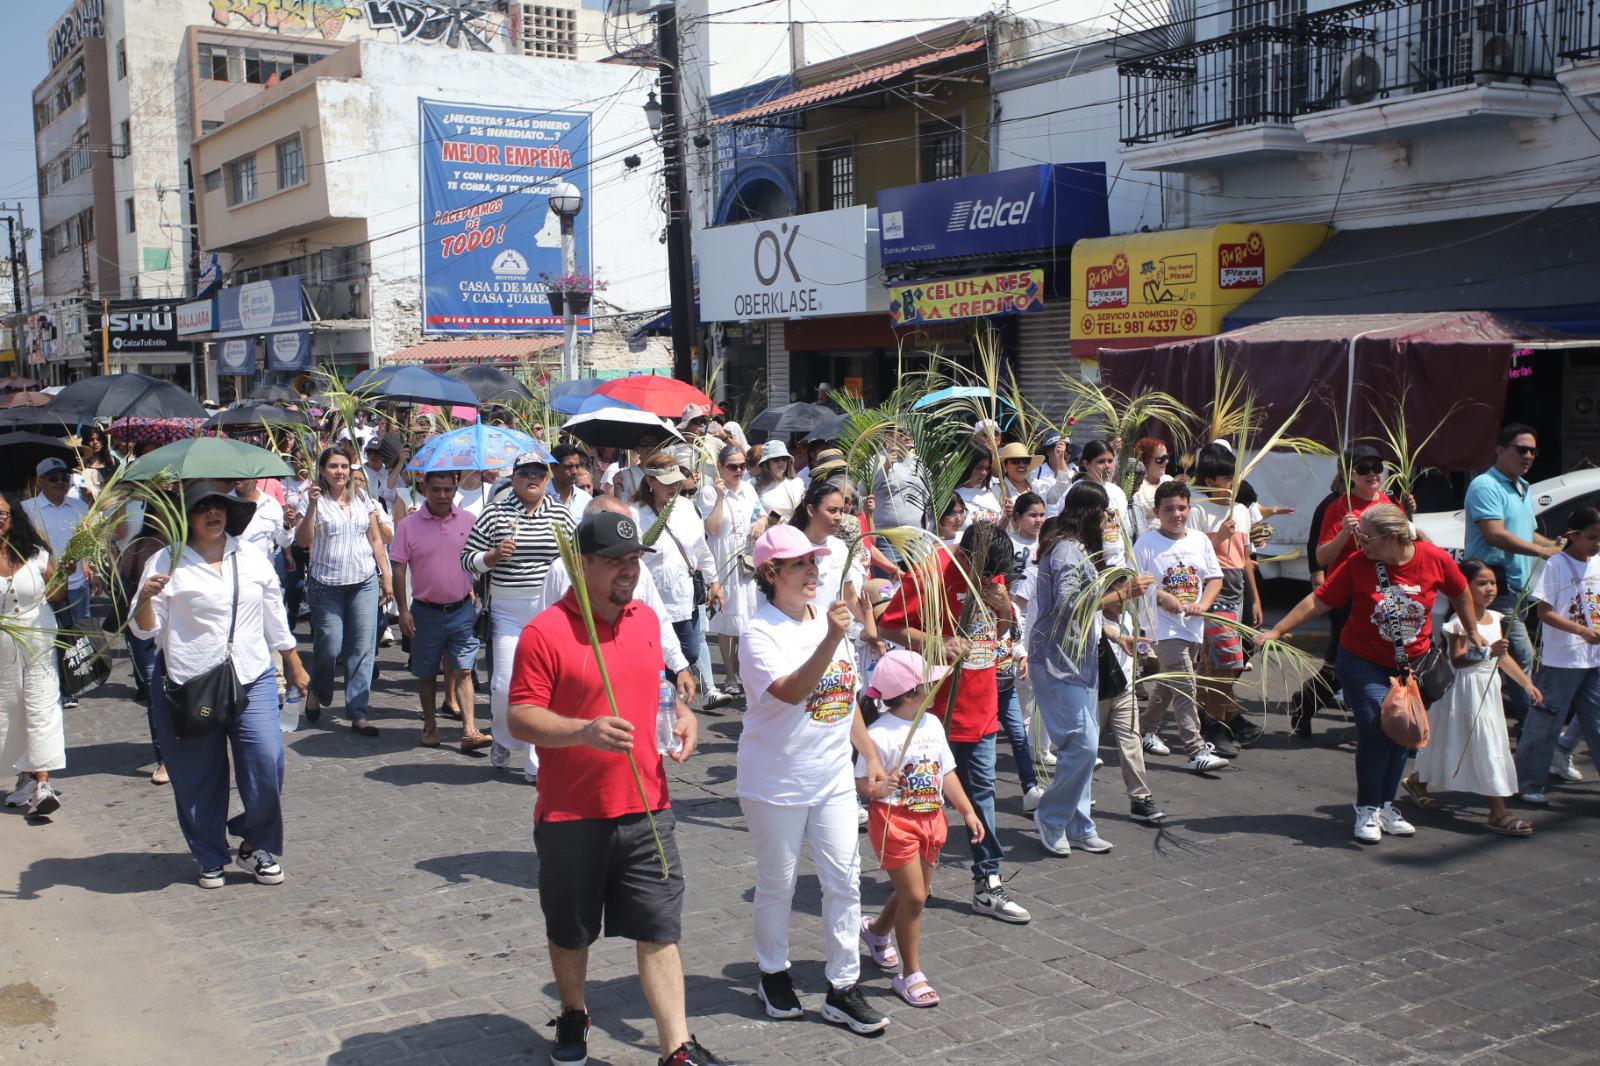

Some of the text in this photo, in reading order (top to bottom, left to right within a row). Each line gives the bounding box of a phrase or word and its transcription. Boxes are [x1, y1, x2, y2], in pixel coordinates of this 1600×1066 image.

[443, 113, 571, 131] ¿NECESITAS MÁS DINERO
[455, 125, 464, 135] Y
[470, 126, 484, 137] DE
[442, 140, 573, 169] MEJOR EMPEÑA
[454, 171, 461, 180] Y
[463, 171, 482, 181] CON
[485, 172, 534, 183] NOSOTROS
[447, 181, 458, 190] TE
[460, 182, 494, 193] COBRA,
[496, 184, 507, 193] NI
[969, 192, 1035, 230] telcel
[465, 218, 480, 230] DE
[441, 223, 507, 258] TODO!
[754, 222, 801, 286] OK
[459, 281, 491, 292] CASA
[493, 282, 500, 293] 5
[502, 282, 520, 293] DE
[926, 271, 1031, 300] CELULARES
[472, 293, 504, 304] CASA
[734, 289, 817, 316] OBERKLASE
[927, 293, 1031, 319] A CREDITO
[101, 305, 173, 331] SHÜ
[1097, 309, 1178, 320] SERVICIO A DOMICILIO
[1097, 319, 1178, 335] TEL: 981 4337
